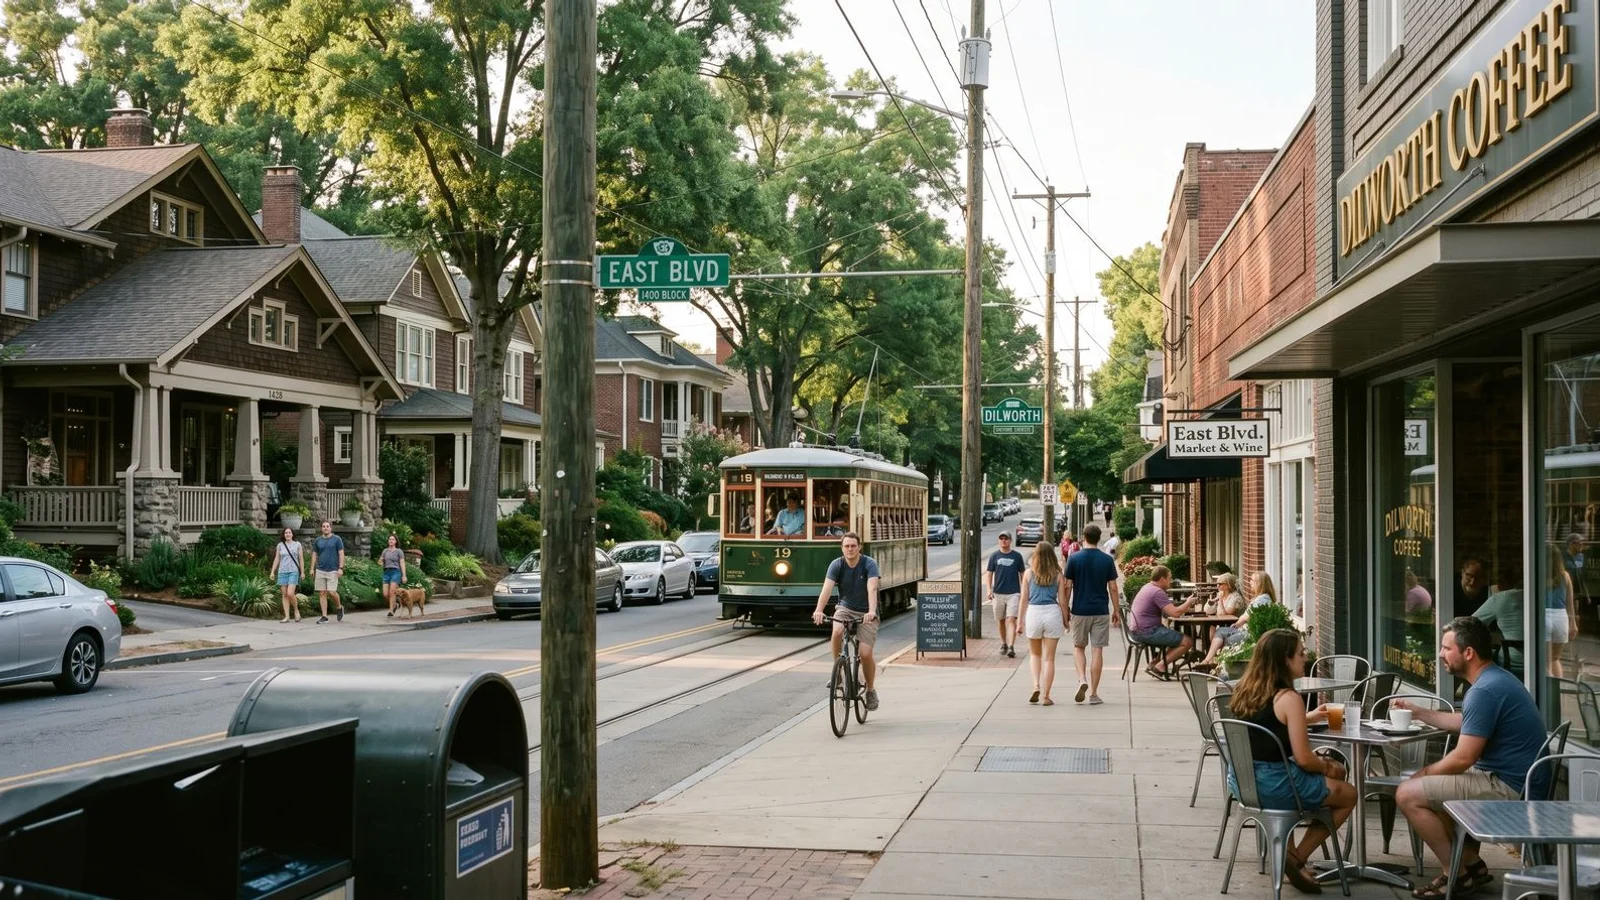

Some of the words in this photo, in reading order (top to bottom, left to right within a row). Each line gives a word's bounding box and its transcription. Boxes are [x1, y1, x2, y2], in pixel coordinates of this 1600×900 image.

[1340, 109, 1443, 257] DILWORTH
[1447, 0, 1573, 172] COFFEE
[609, 261, 659, 283] EAST
[669, 260, 719, 282] BLVD
[641, 290, 660, 300] 1400
[661, 290, 687, 300] BLOCK
[985, 410, 1041, 421] DILWORTH
[1174, 426, 1212, 440] East
[1217, 424, 1264, 439] Blvd.
[1175, 443, 1216, 453] Market
[1219, 443, 1230, 453] &
[1233, 442, 1263, 452] Wine
[741, 474, 752, 482] 19
[1385, 505, 1431, 539] DILWORTH
[774, 547, 792, 558] 19
[1394, 539, 1421, 557] COFFEE
